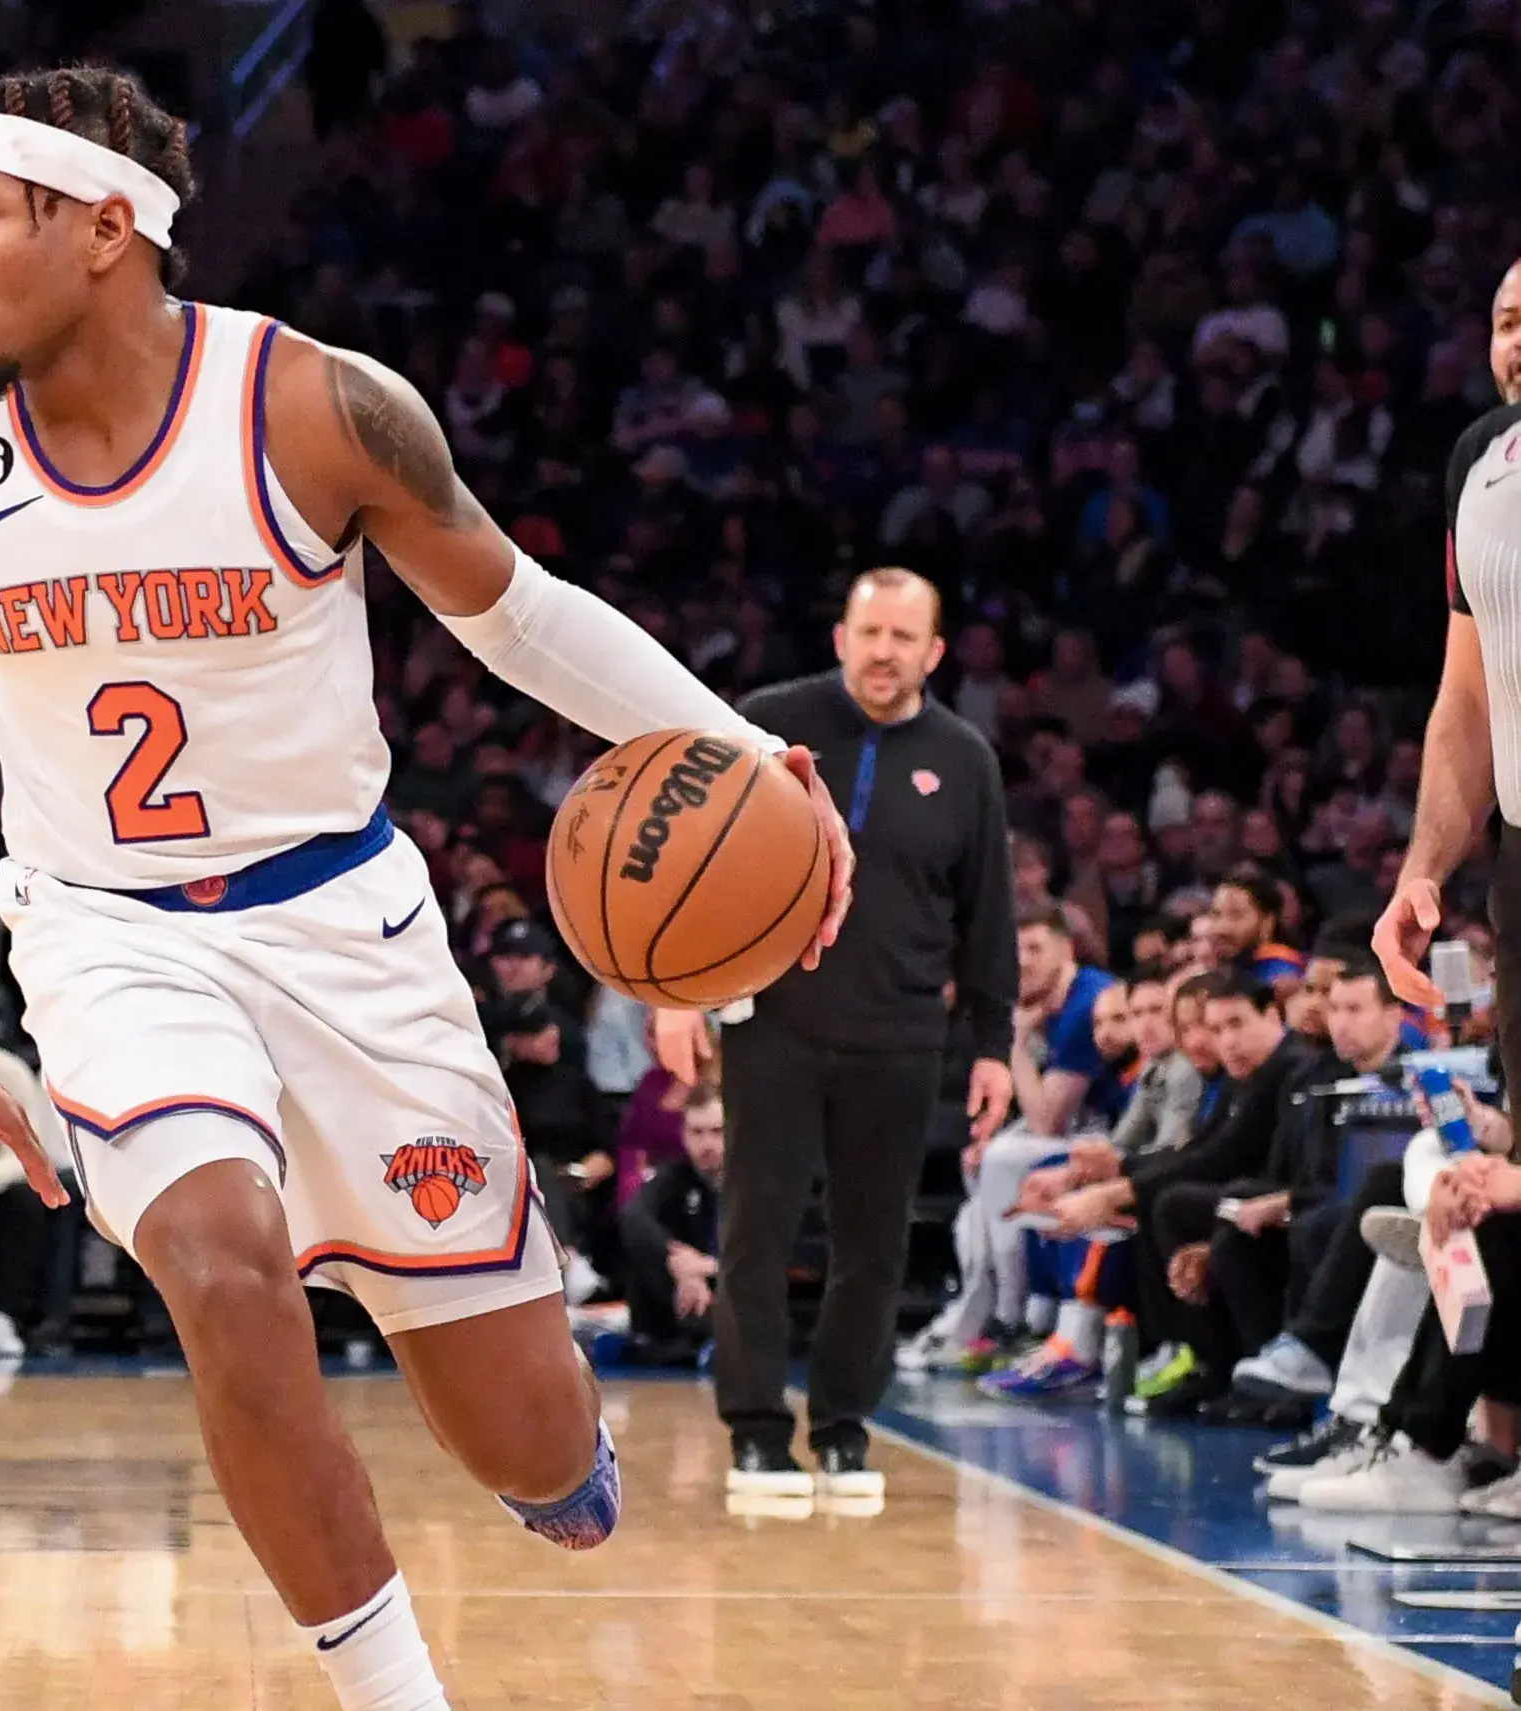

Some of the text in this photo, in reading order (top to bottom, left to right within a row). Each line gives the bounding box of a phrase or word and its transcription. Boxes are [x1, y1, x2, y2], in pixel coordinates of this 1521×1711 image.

[97, 567, 279, 644] YORK
[87, 680, 212, 846] 2
[619, 736, 743, 884] Wilson
[383, 1143, 488, 1190] KNICKS
